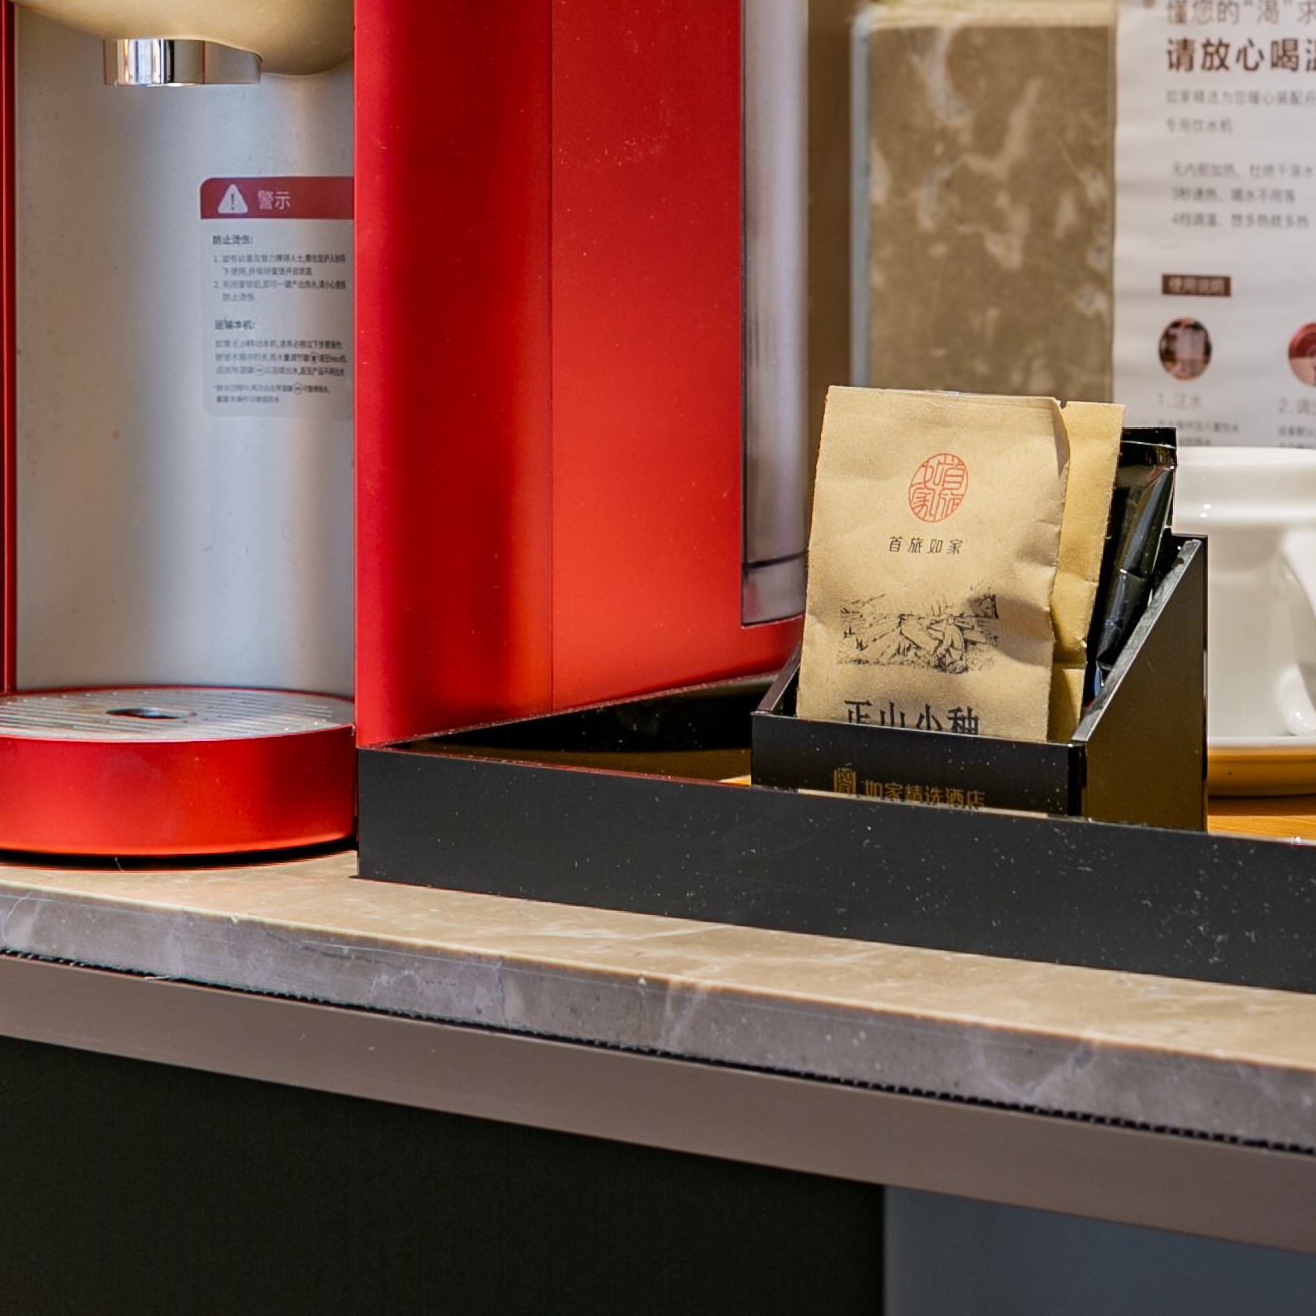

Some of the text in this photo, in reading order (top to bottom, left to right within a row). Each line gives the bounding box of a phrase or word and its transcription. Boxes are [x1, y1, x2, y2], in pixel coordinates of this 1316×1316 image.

[257, 190, 291, 210] 警示
[887, 535, 963, 557] 首旅如家
[843, 699, 980, 735] 正山小种
